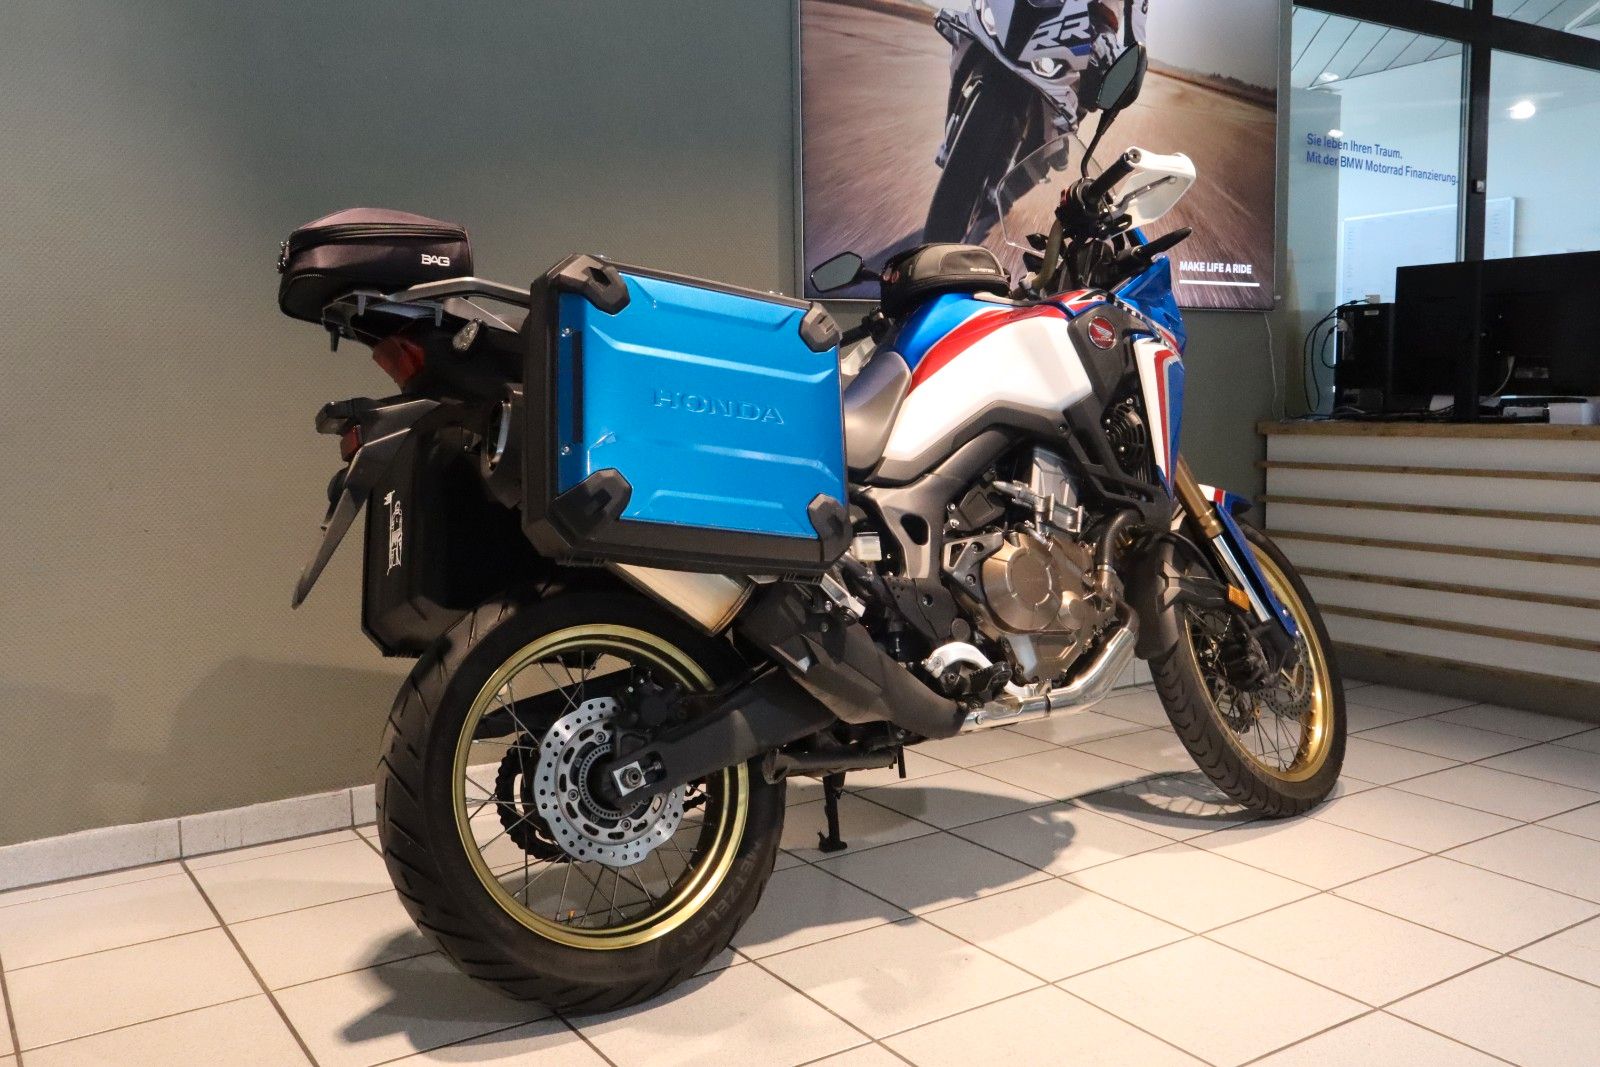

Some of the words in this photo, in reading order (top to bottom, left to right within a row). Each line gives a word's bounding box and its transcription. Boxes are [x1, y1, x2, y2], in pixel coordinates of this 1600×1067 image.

[1307, 132, 1322, 147] Sie
[1324, 136, 1348, 150] leben
[1350, 140, 1373, 154] Ihren
[1374, 144, 1402, 159] Traum.
[1306, 151, 1322, 164] Mit
[1323, 155, 1338, 166] der
[1340, 156, 1363, 170] BMW
[1365, 161, 1403, 176] Motorrad
[1405, 166, 1459, 186] Finanzierung.
[421, 254, 450, 267] BAG
[1180, 261, 1205, 272] MAKE
[1206, 262, 1224, 273] LIFE
[1225, 263, 1232, 274] A
[1233, 264, 1252, 274] RIDE
[652, 389, 785, 425] HONDA
